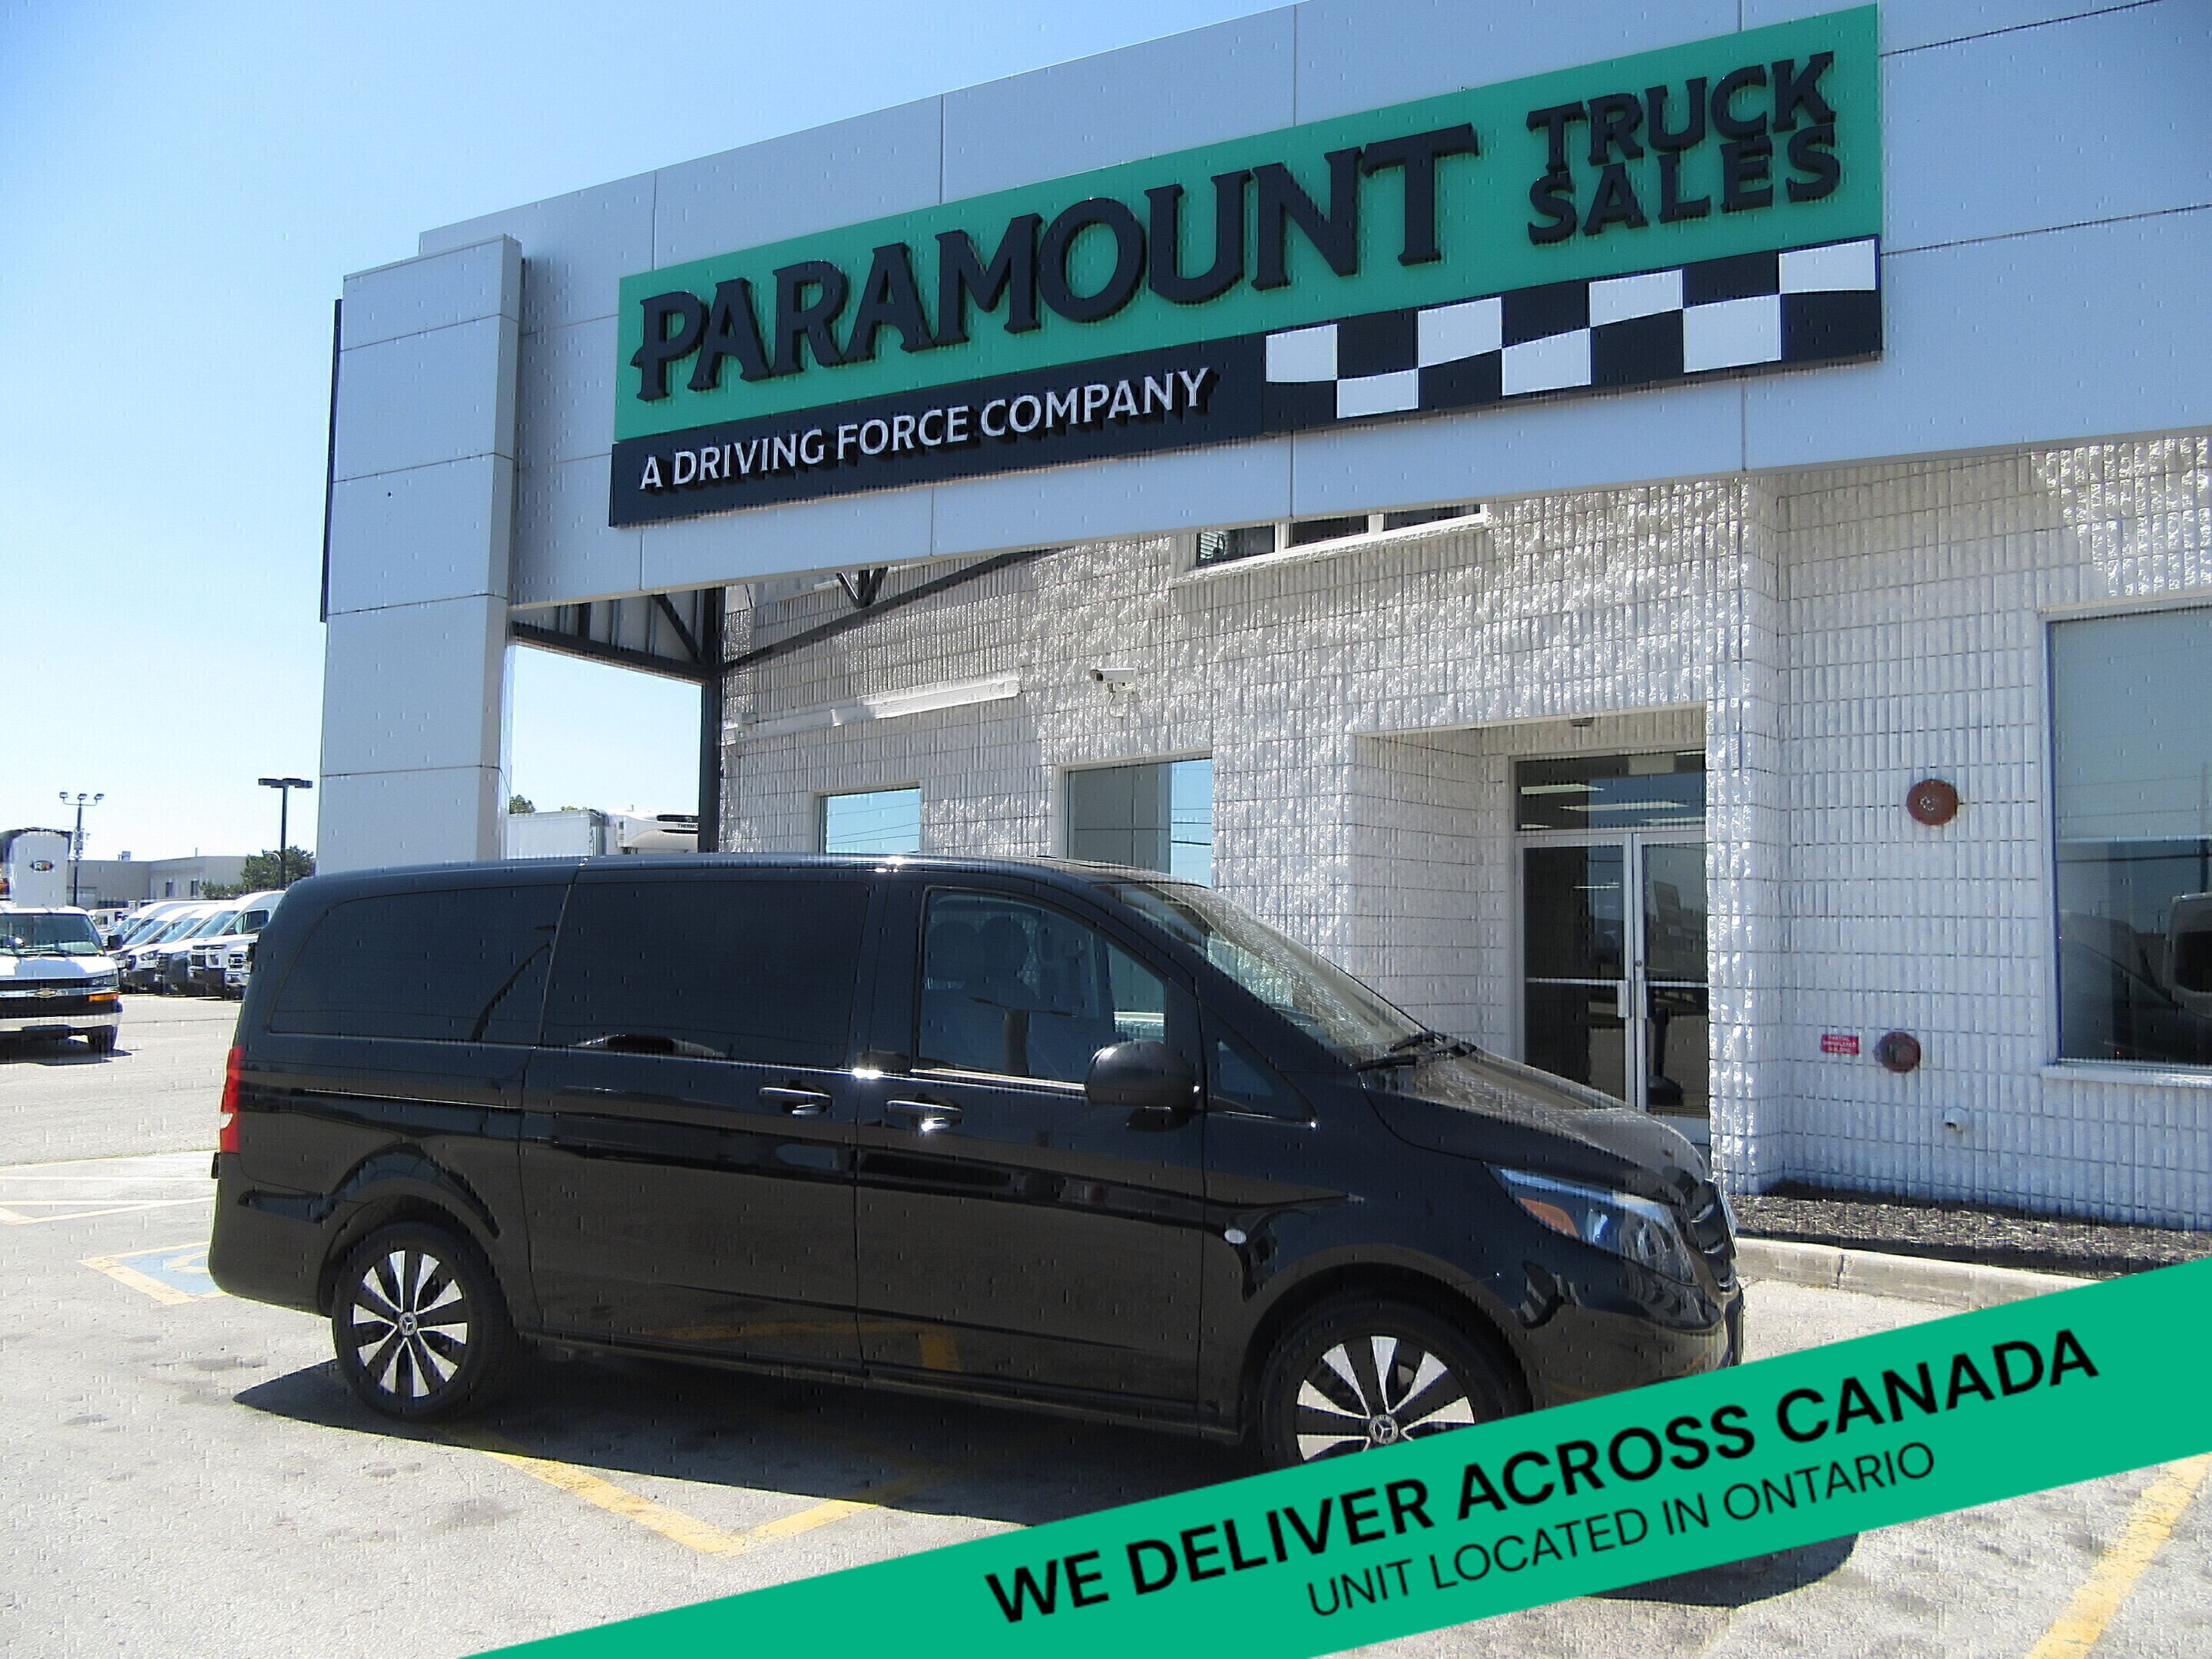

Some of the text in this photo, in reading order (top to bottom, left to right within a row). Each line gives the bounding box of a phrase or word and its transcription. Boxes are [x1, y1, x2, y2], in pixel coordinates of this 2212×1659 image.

[1526, 51, 1836, 174] TRUCK
[1527, 124, 1840, 246] SALES
[630, 123, 1479, 402] PARAMOUNT
[639, 367, 1210, 490] A DRIVING FORCE COMPANY
